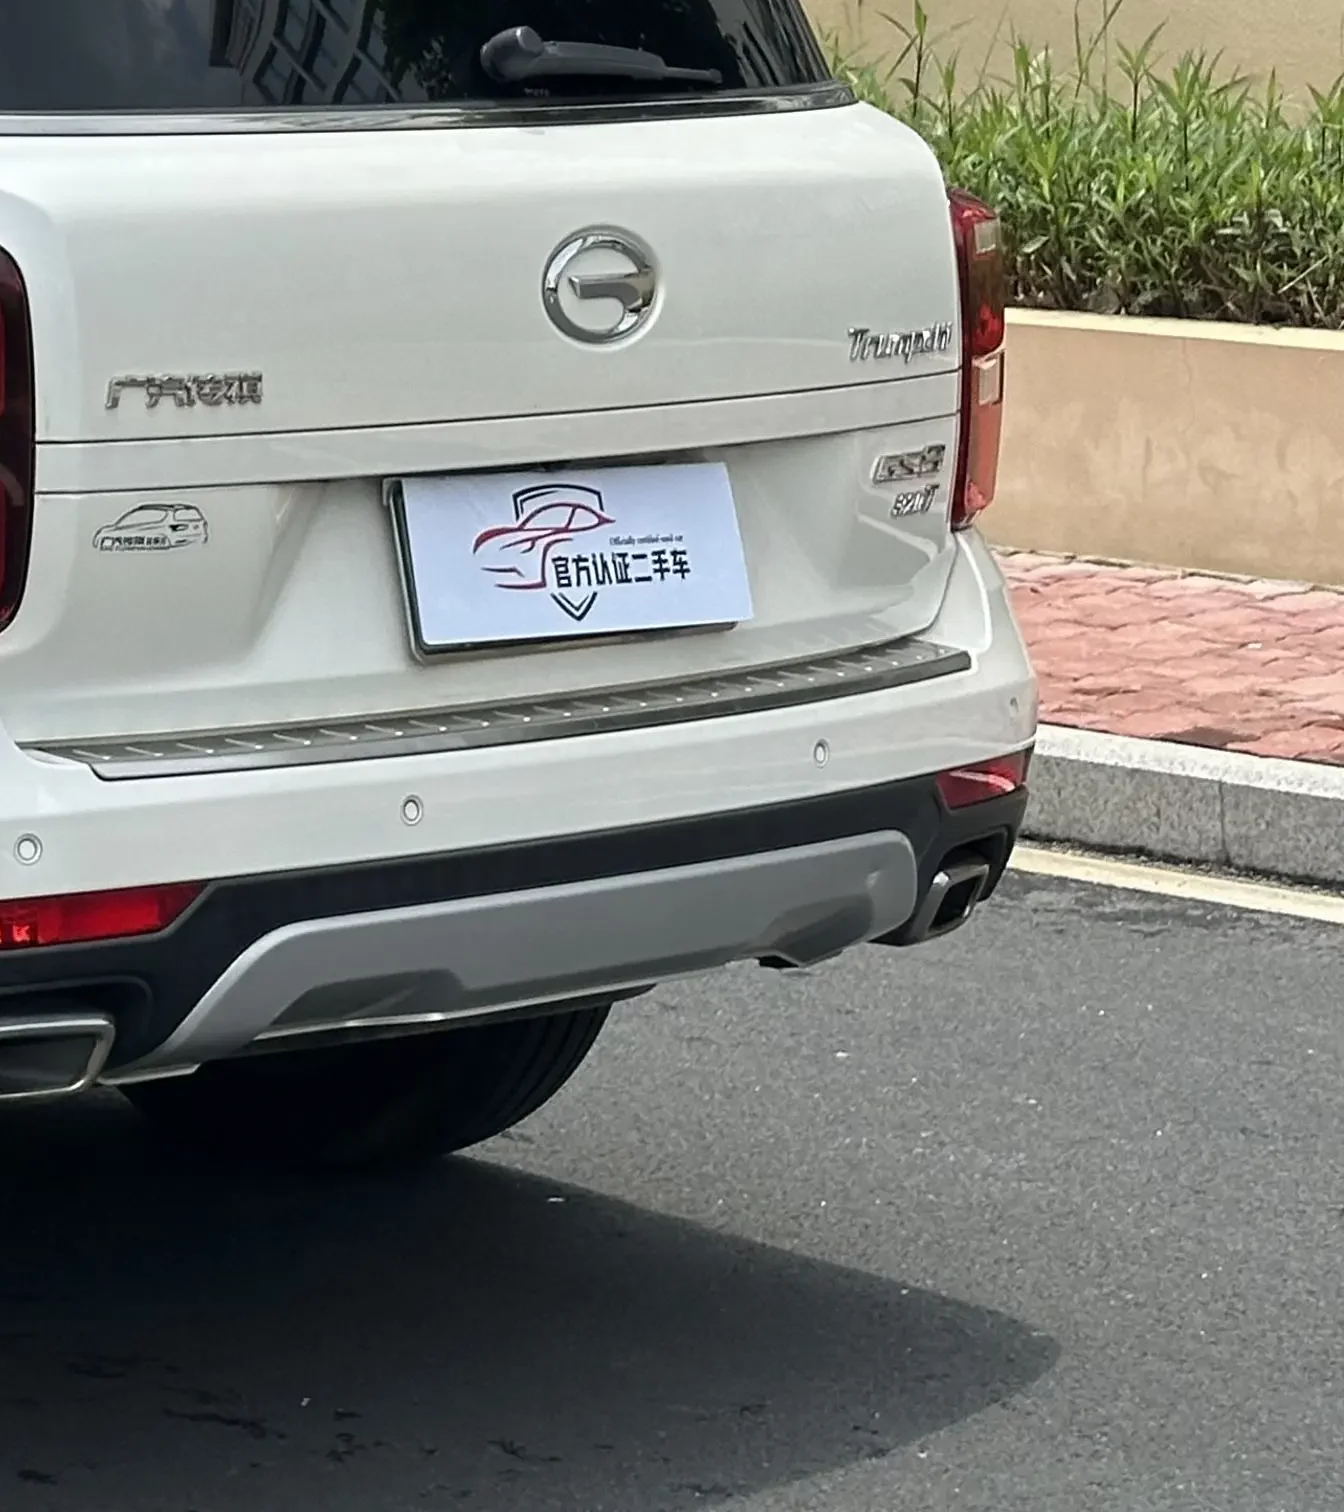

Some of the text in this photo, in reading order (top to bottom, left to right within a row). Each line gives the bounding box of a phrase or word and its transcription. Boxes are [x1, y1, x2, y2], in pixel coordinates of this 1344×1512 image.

[848, 321, 952, 365] Trumpchi
[104, 372, 263, 410] 广汽传祺
[551, 549, 691, 588] 官方认证二手车
